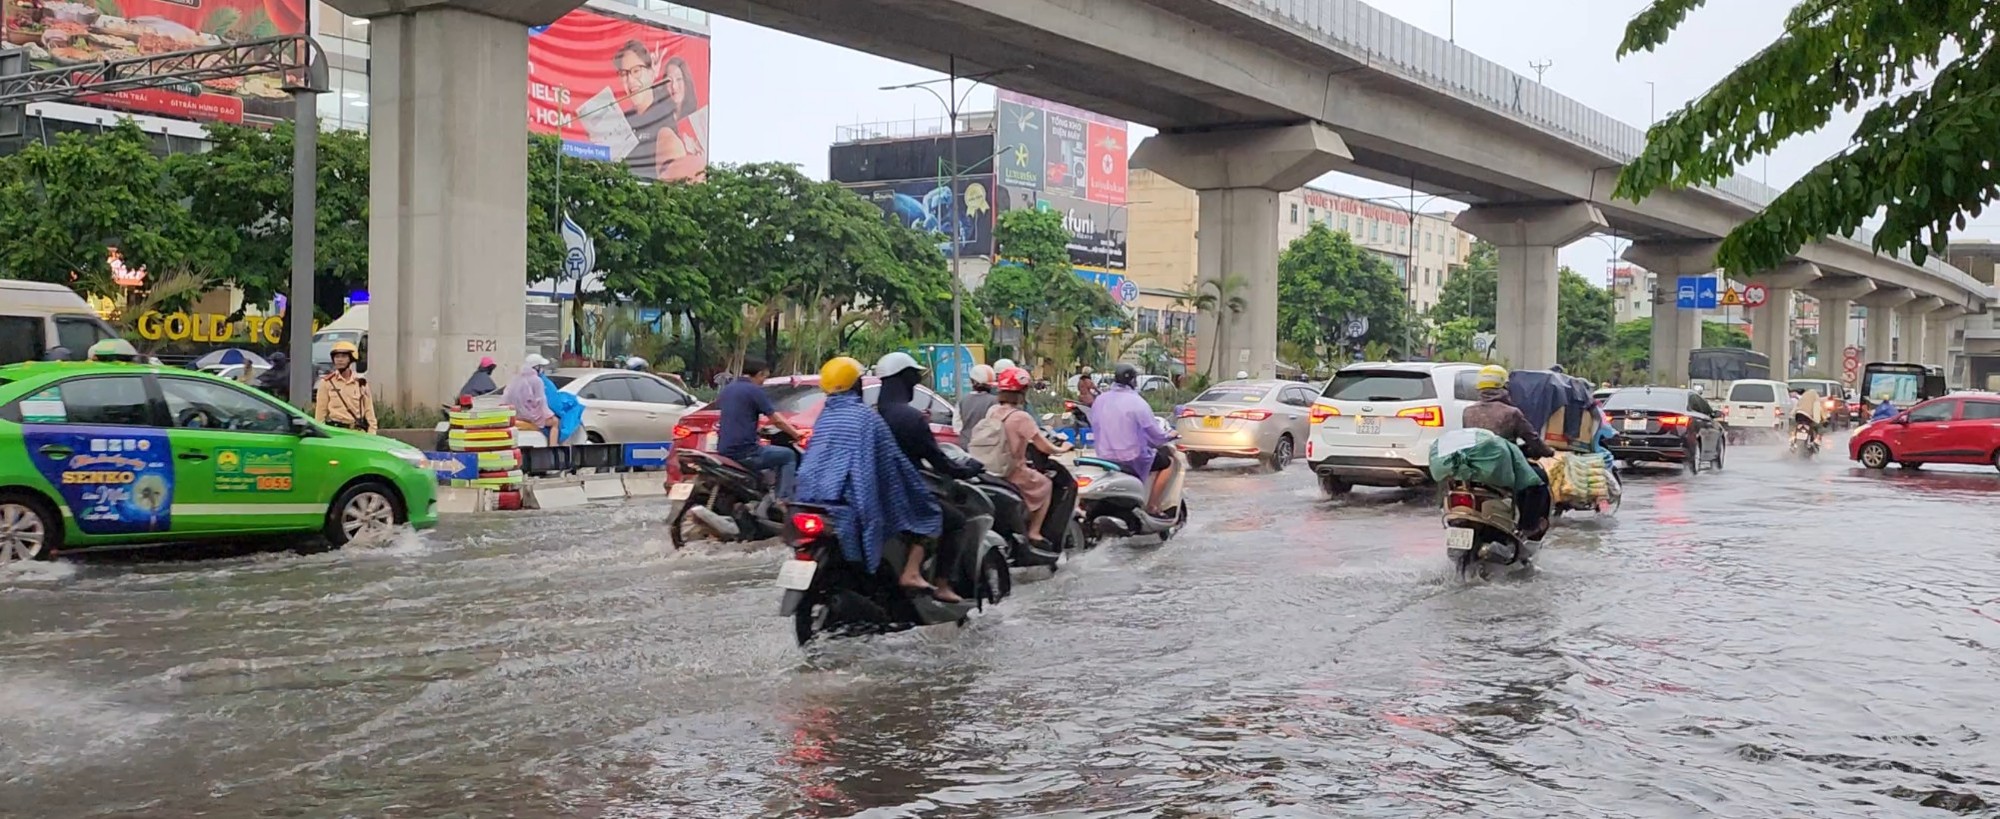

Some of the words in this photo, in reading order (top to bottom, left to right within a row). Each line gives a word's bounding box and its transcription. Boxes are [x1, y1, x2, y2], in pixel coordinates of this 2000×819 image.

[532, 83, 571, 105] IELTS
[536, 107, 572, 129] HCM
[138, 310, 233, 343] GOLD
[467, 339, 497, 352] ER21
[62, 471, 135, 484] SENKO
[256, 476, 292, 491] 1055
